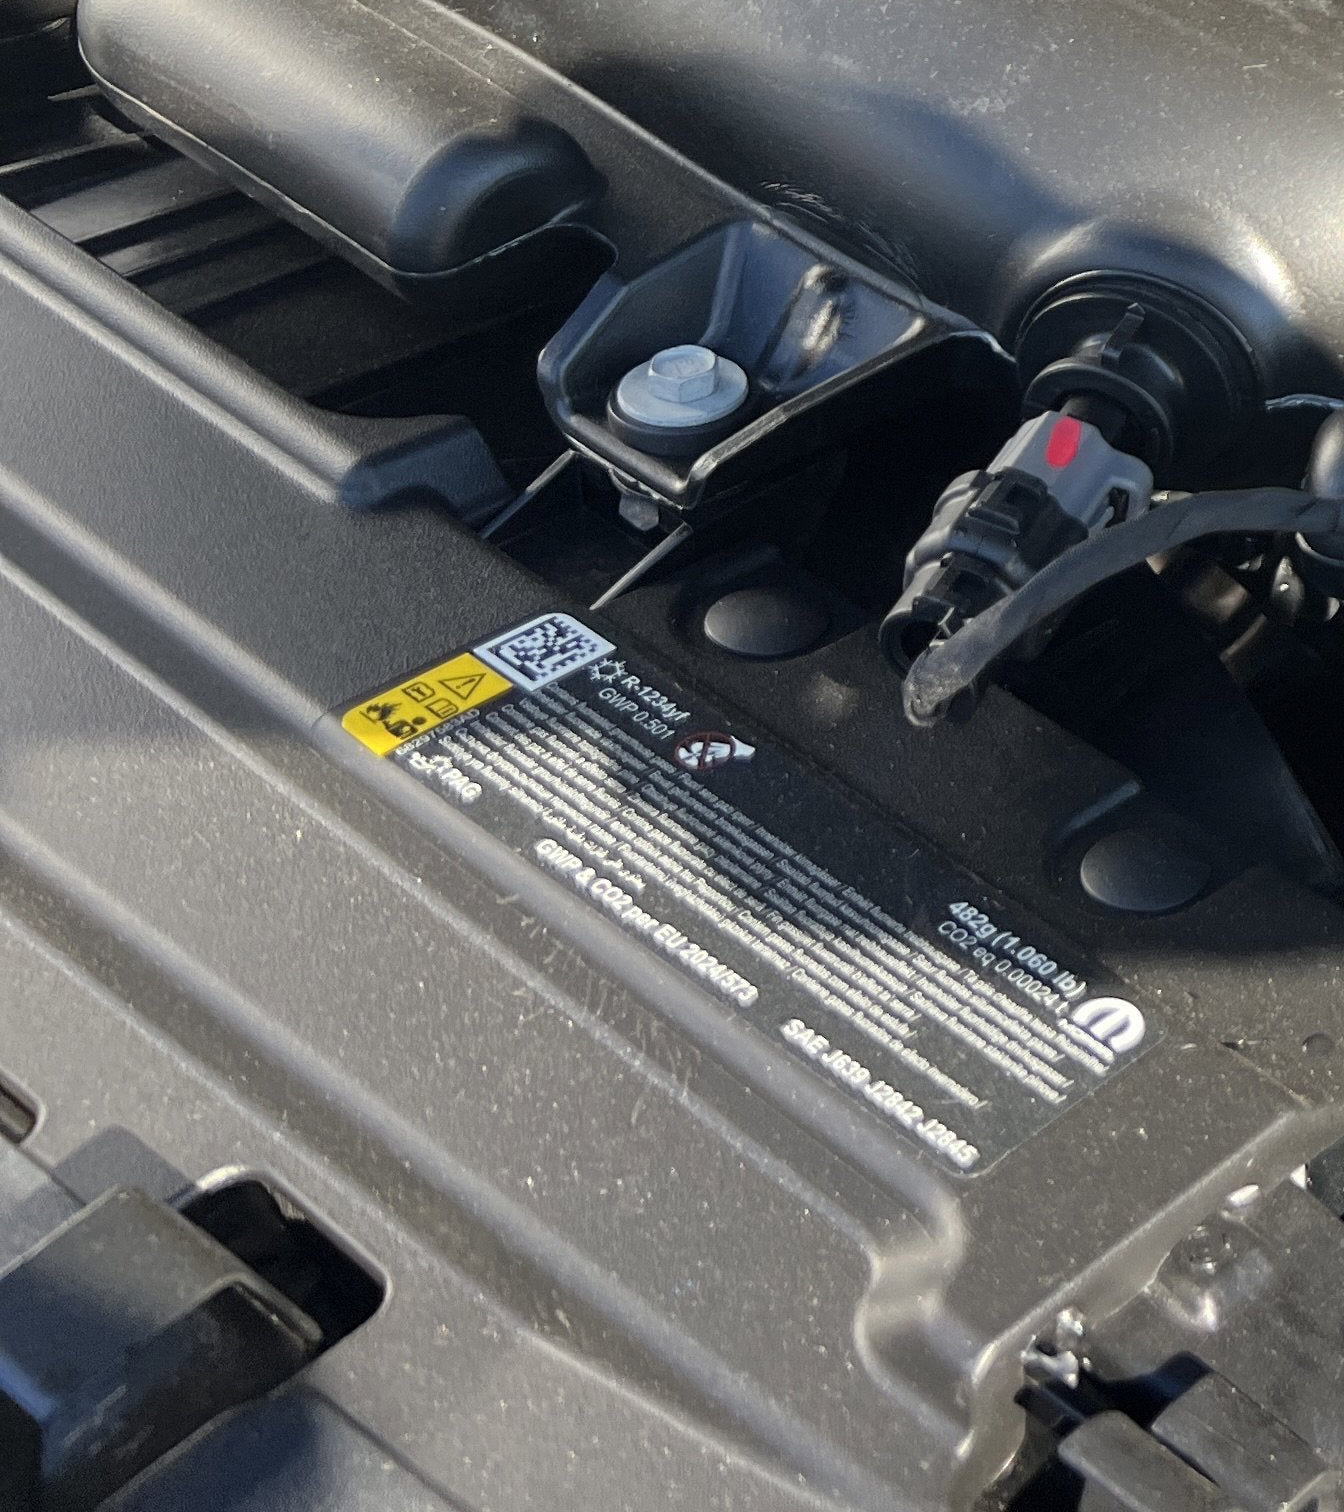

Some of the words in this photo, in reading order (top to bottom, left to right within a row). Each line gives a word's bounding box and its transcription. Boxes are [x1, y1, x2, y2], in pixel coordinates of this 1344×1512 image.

[597, 687, 639, 711] GWP
[631, 710, 675, 739] 0.501
[620, 674, 690, 721] R-1234yf
[439, 767, 482, 801] PAG
[533, 838, 582, 871] GWP
[574, 867, 595, 886] &
[589, 877, 632, 911] CO2
[620, 905, 659, 932] per
[652, 923, 688, 951] EU
[676, 942, 759, 1002] 2024/573
[937, 920, 977, 949] CO2
[972, 946, 996, 967] eq
[993, 958, 1059, 1006] 0.00024
[948, 901, 997, 938] 482g
[990, 931, 1057, 975] (1.060
[1051, 970, 1086, 998] lb)
[781, 1018, 829, 1054] SAE
[818, 1048, 870, 1086] J639
[860, 1079, 924, 1124] J2842
[914, 1118, 979, 1164] J2845
